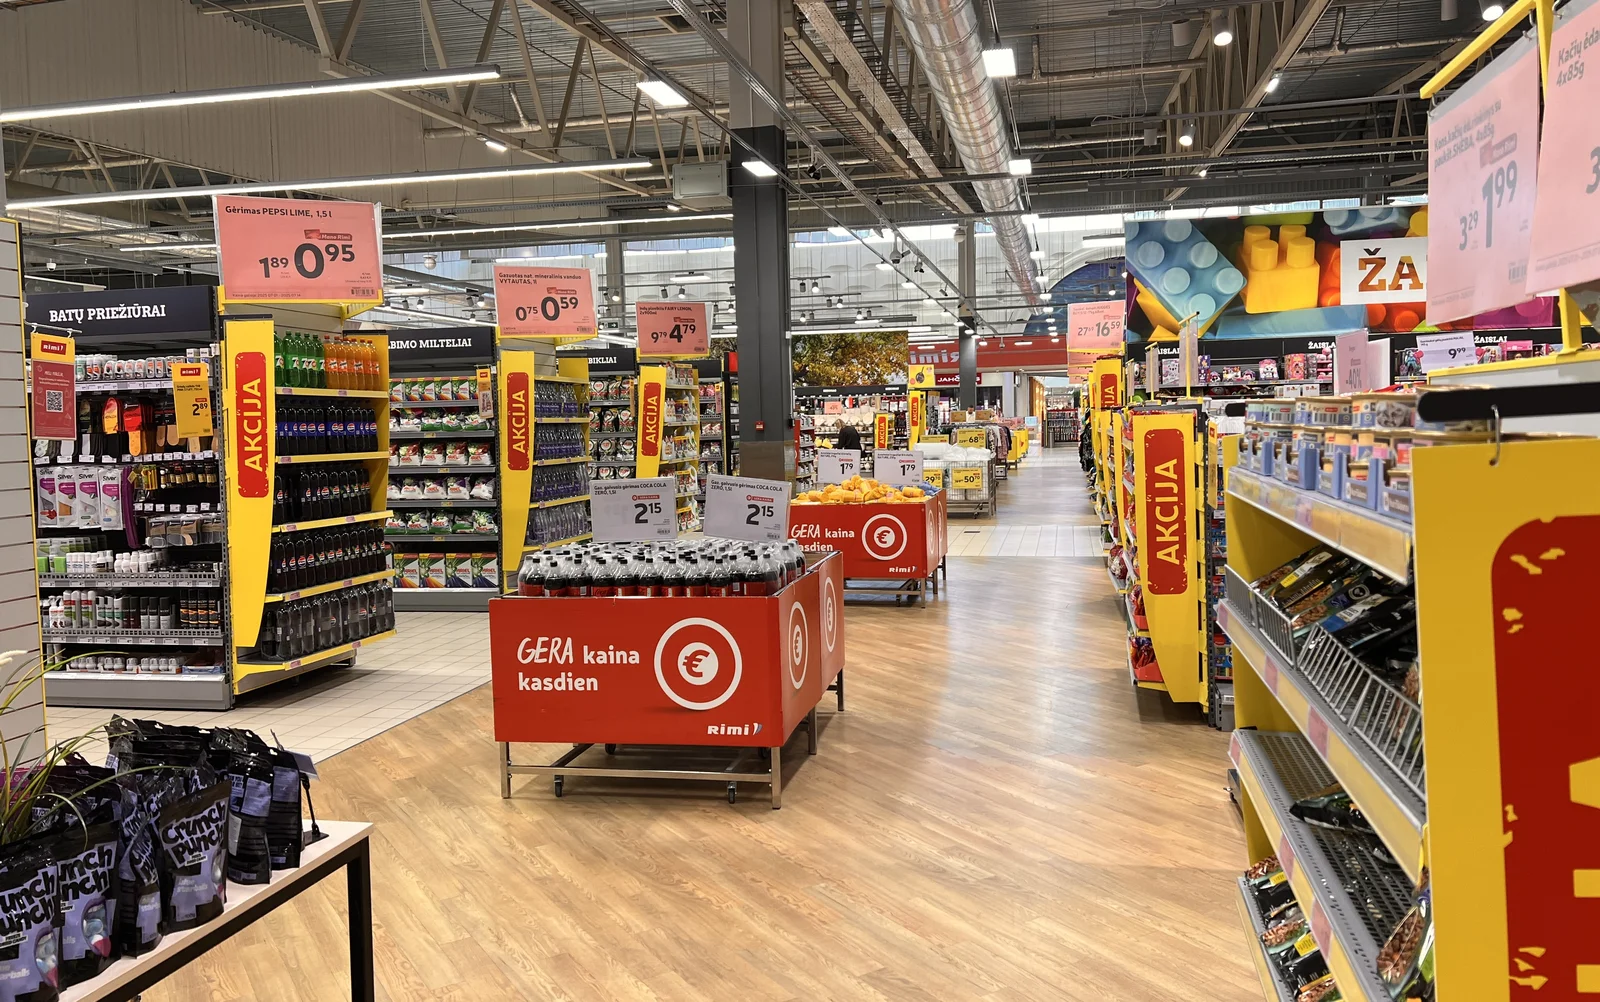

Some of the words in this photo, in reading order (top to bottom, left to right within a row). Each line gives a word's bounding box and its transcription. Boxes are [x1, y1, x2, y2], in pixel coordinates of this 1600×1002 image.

[1556, 61, 1584, 87] 4x85g
[225, 205, 261, 215] Gėrimas
[262, 208, 288, 217] PEPSI
[290, 209, 313, 218] LIME,
[49, 309, 84, 324] BATŲ
[87, 303, 166, 320] PRIEŽIŪRAI
[419, 338, 472, 348] MILTELIAI
[242, 378, 263, 472] AKCIJA
[512, 390, 526, 454] AKCIJA
[645, 395, 658, 444] AKCIJA
[1155, 458, 1180, 566] AKCIJA
[791, 524, 821, 538] GERA
[825, 528, 855, 538] kaina
[517, 636, 574, 665] GERA
[583, 646, 640, 665] kaina
[518, 672, 599, 692] kasdien
[707, 723, 750, 736] Rimi
